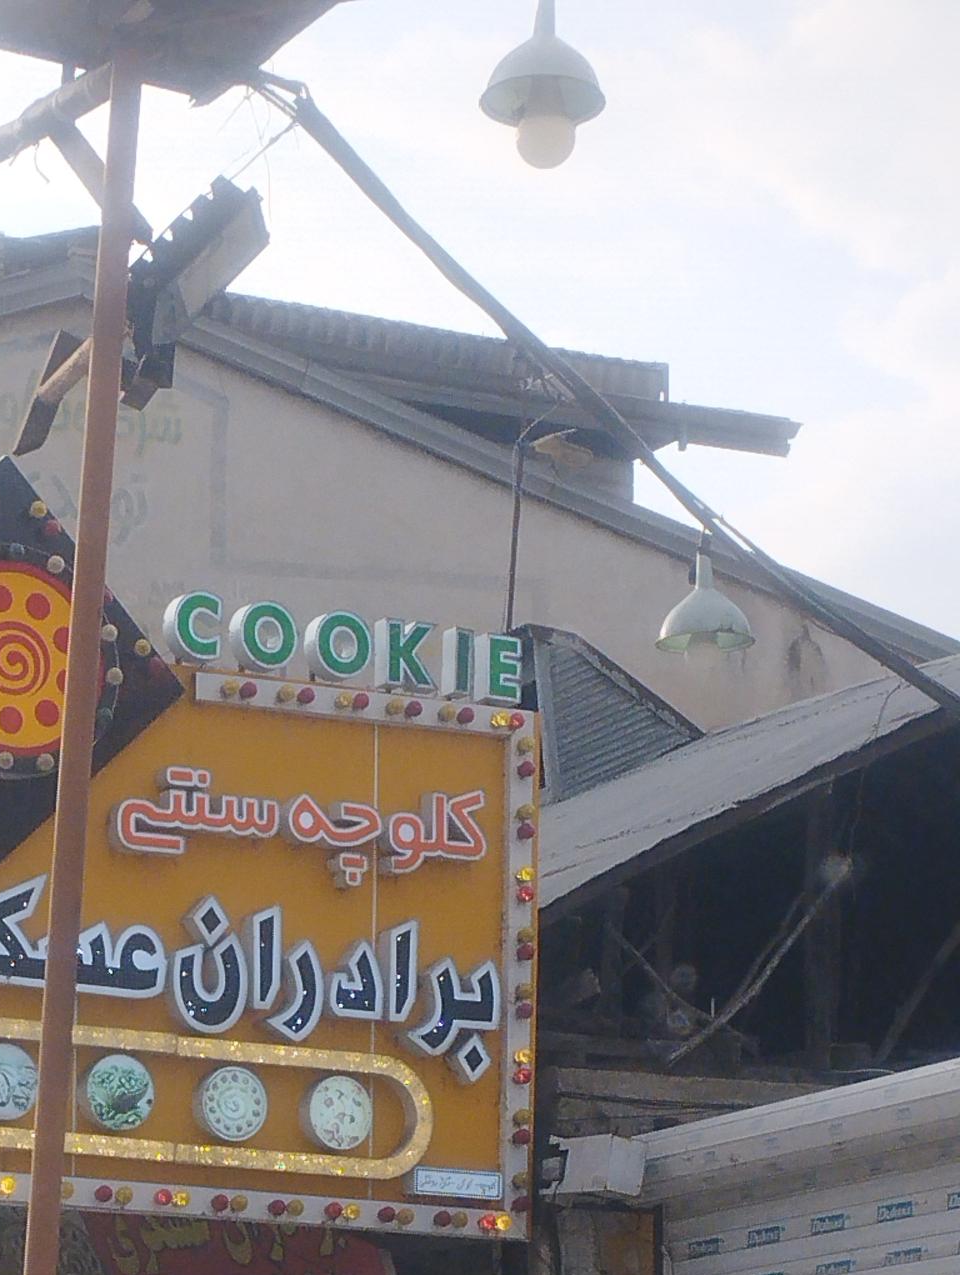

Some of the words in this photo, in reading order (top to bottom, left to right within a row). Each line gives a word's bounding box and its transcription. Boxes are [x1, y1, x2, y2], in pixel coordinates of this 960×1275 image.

[164, 590, 523, 704] COOKIE
[116, 766, 280, 855] سنتی
[287, 790, 486, 887] کلوچه
[172, 894, 502, 1082] برادران
